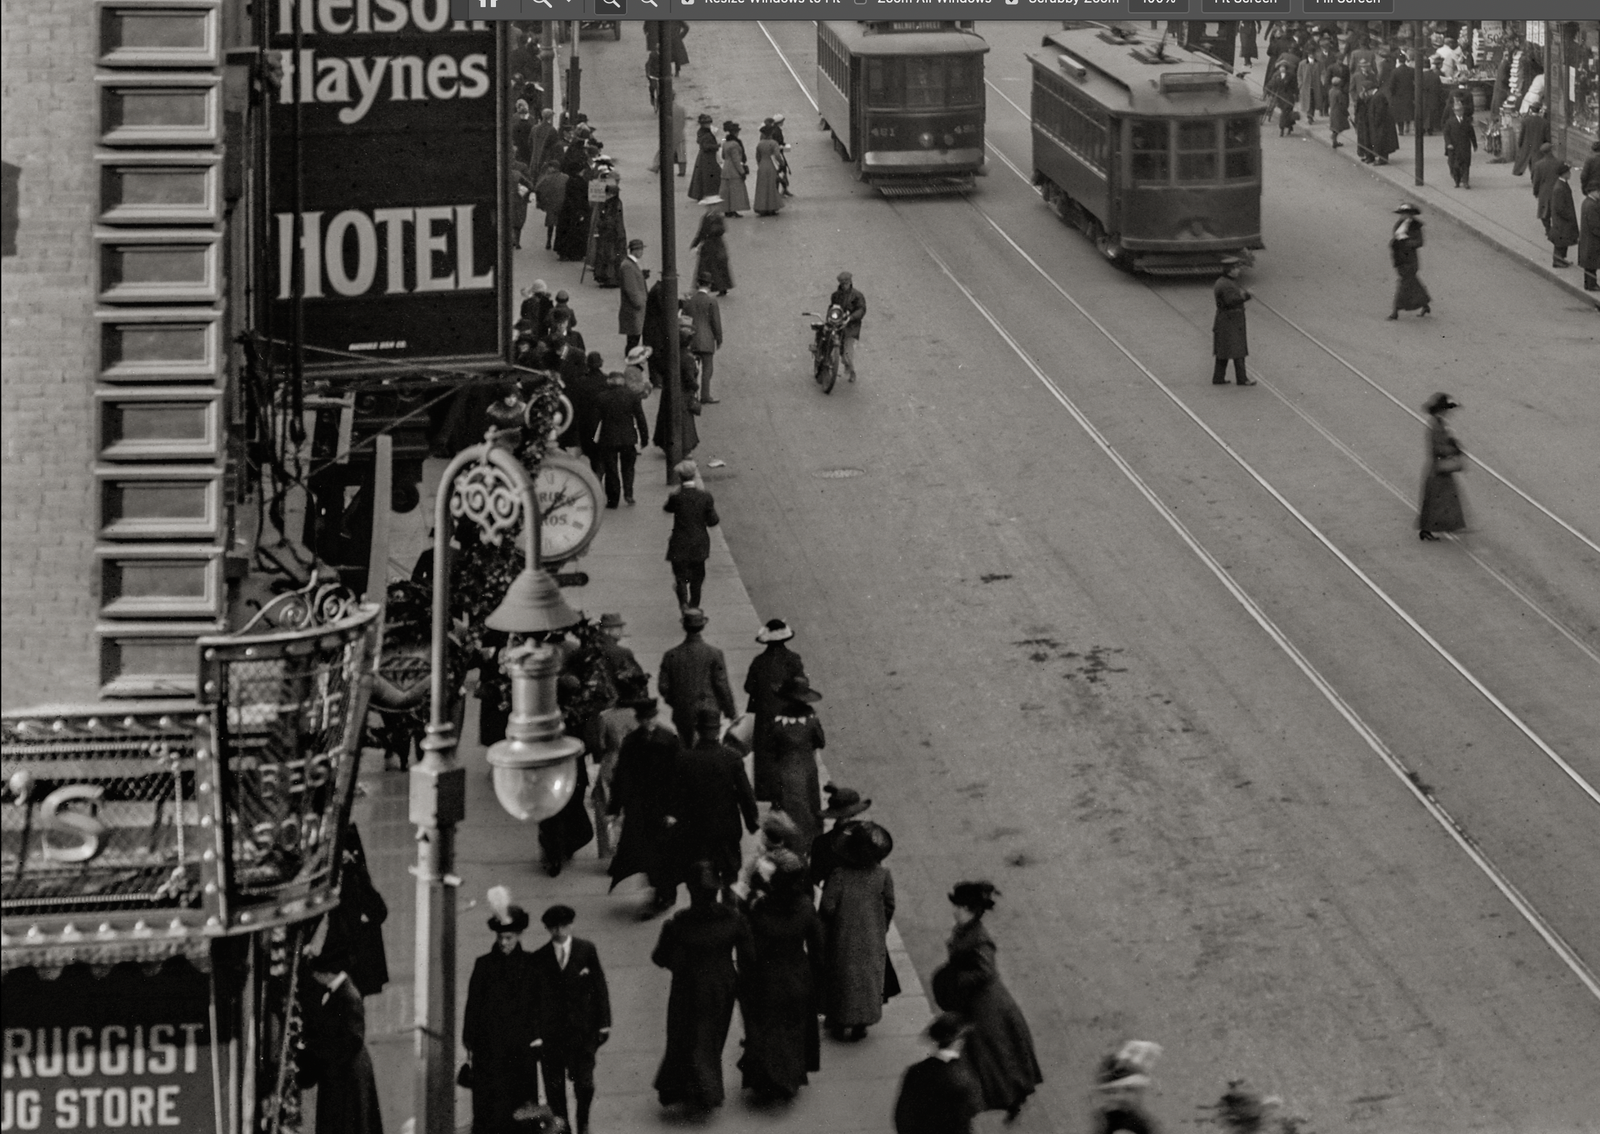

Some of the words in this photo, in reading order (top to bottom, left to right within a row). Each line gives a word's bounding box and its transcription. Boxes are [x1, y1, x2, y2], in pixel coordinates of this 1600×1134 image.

[275, 48, 490, 124] Haynes
[274, 204, 495, 299] HOTEL
[3, 1022, 205, 1079] RUGGIST
[55, 1084, 182, 1129] STORE
